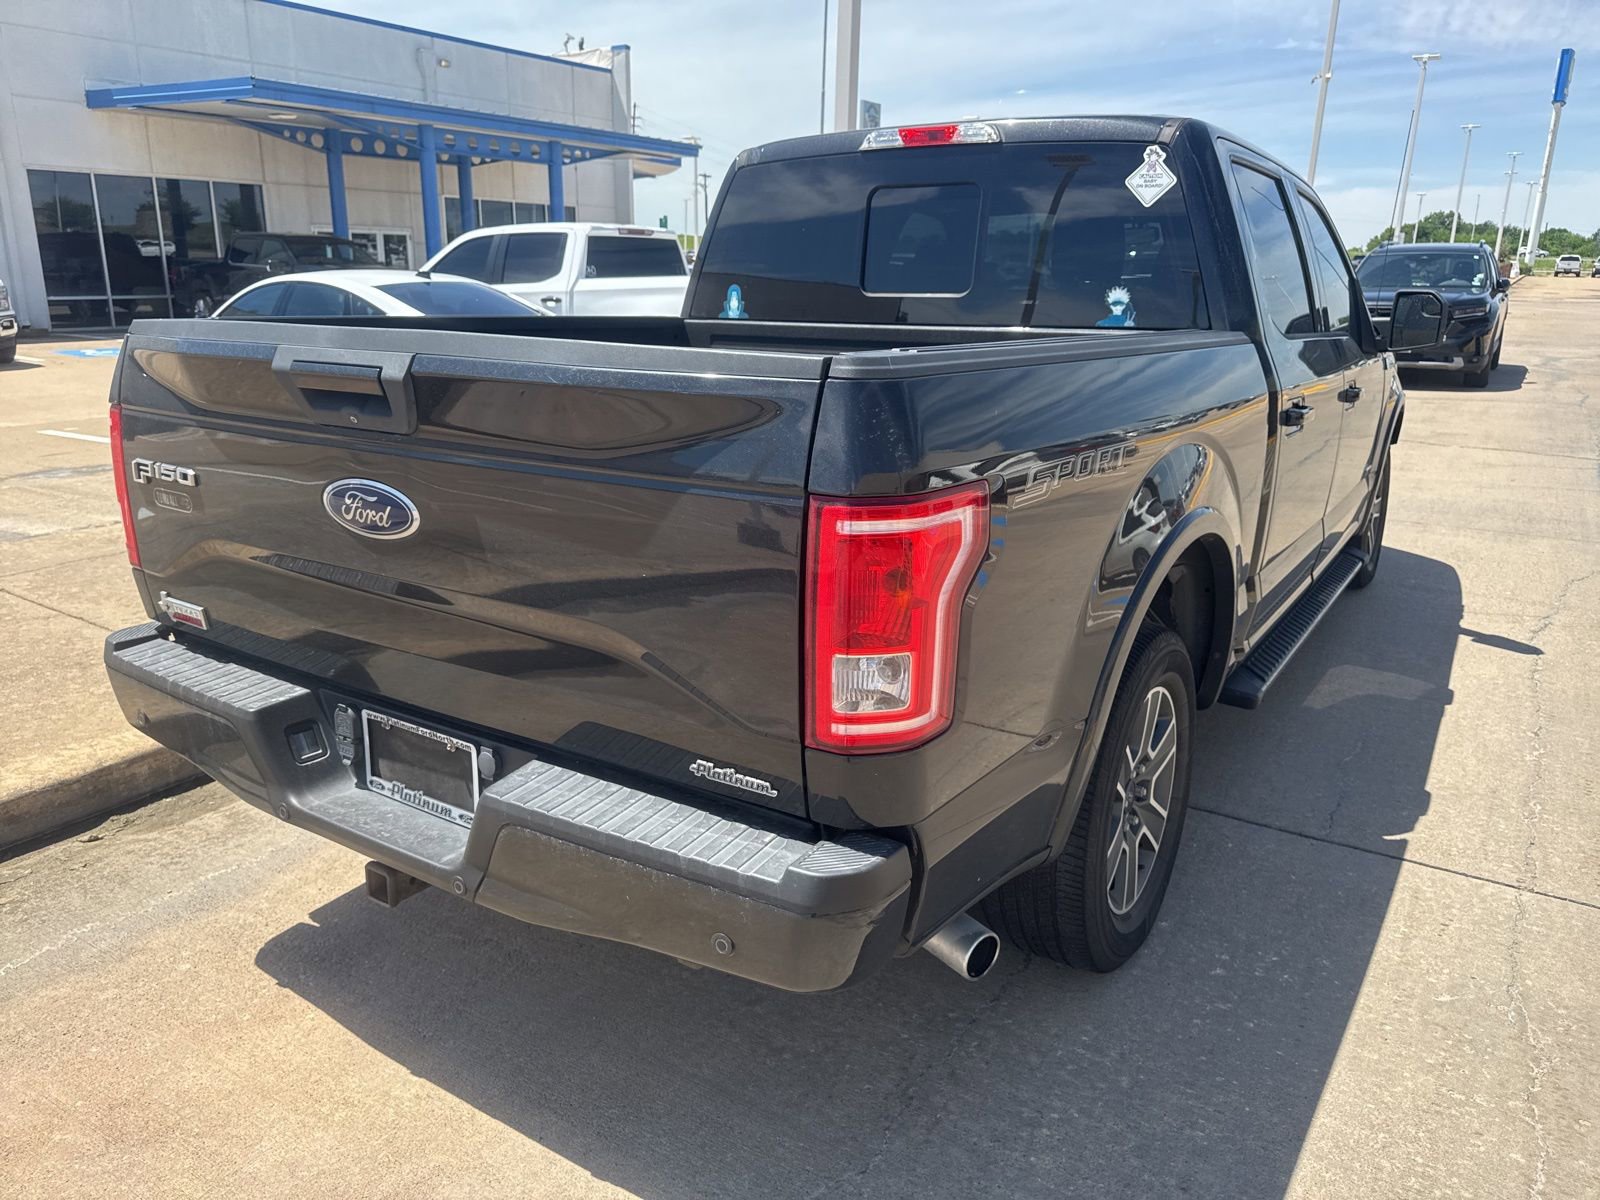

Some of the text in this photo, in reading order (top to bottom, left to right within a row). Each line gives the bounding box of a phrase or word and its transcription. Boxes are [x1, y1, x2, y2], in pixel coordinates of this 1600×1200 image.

[1012, 439, 1137, 510] SPORT
[341, 490, 392, 528] Ford
[690, 760, 778, 797] Platinum
[388, 781, 456, 820] Platinum
